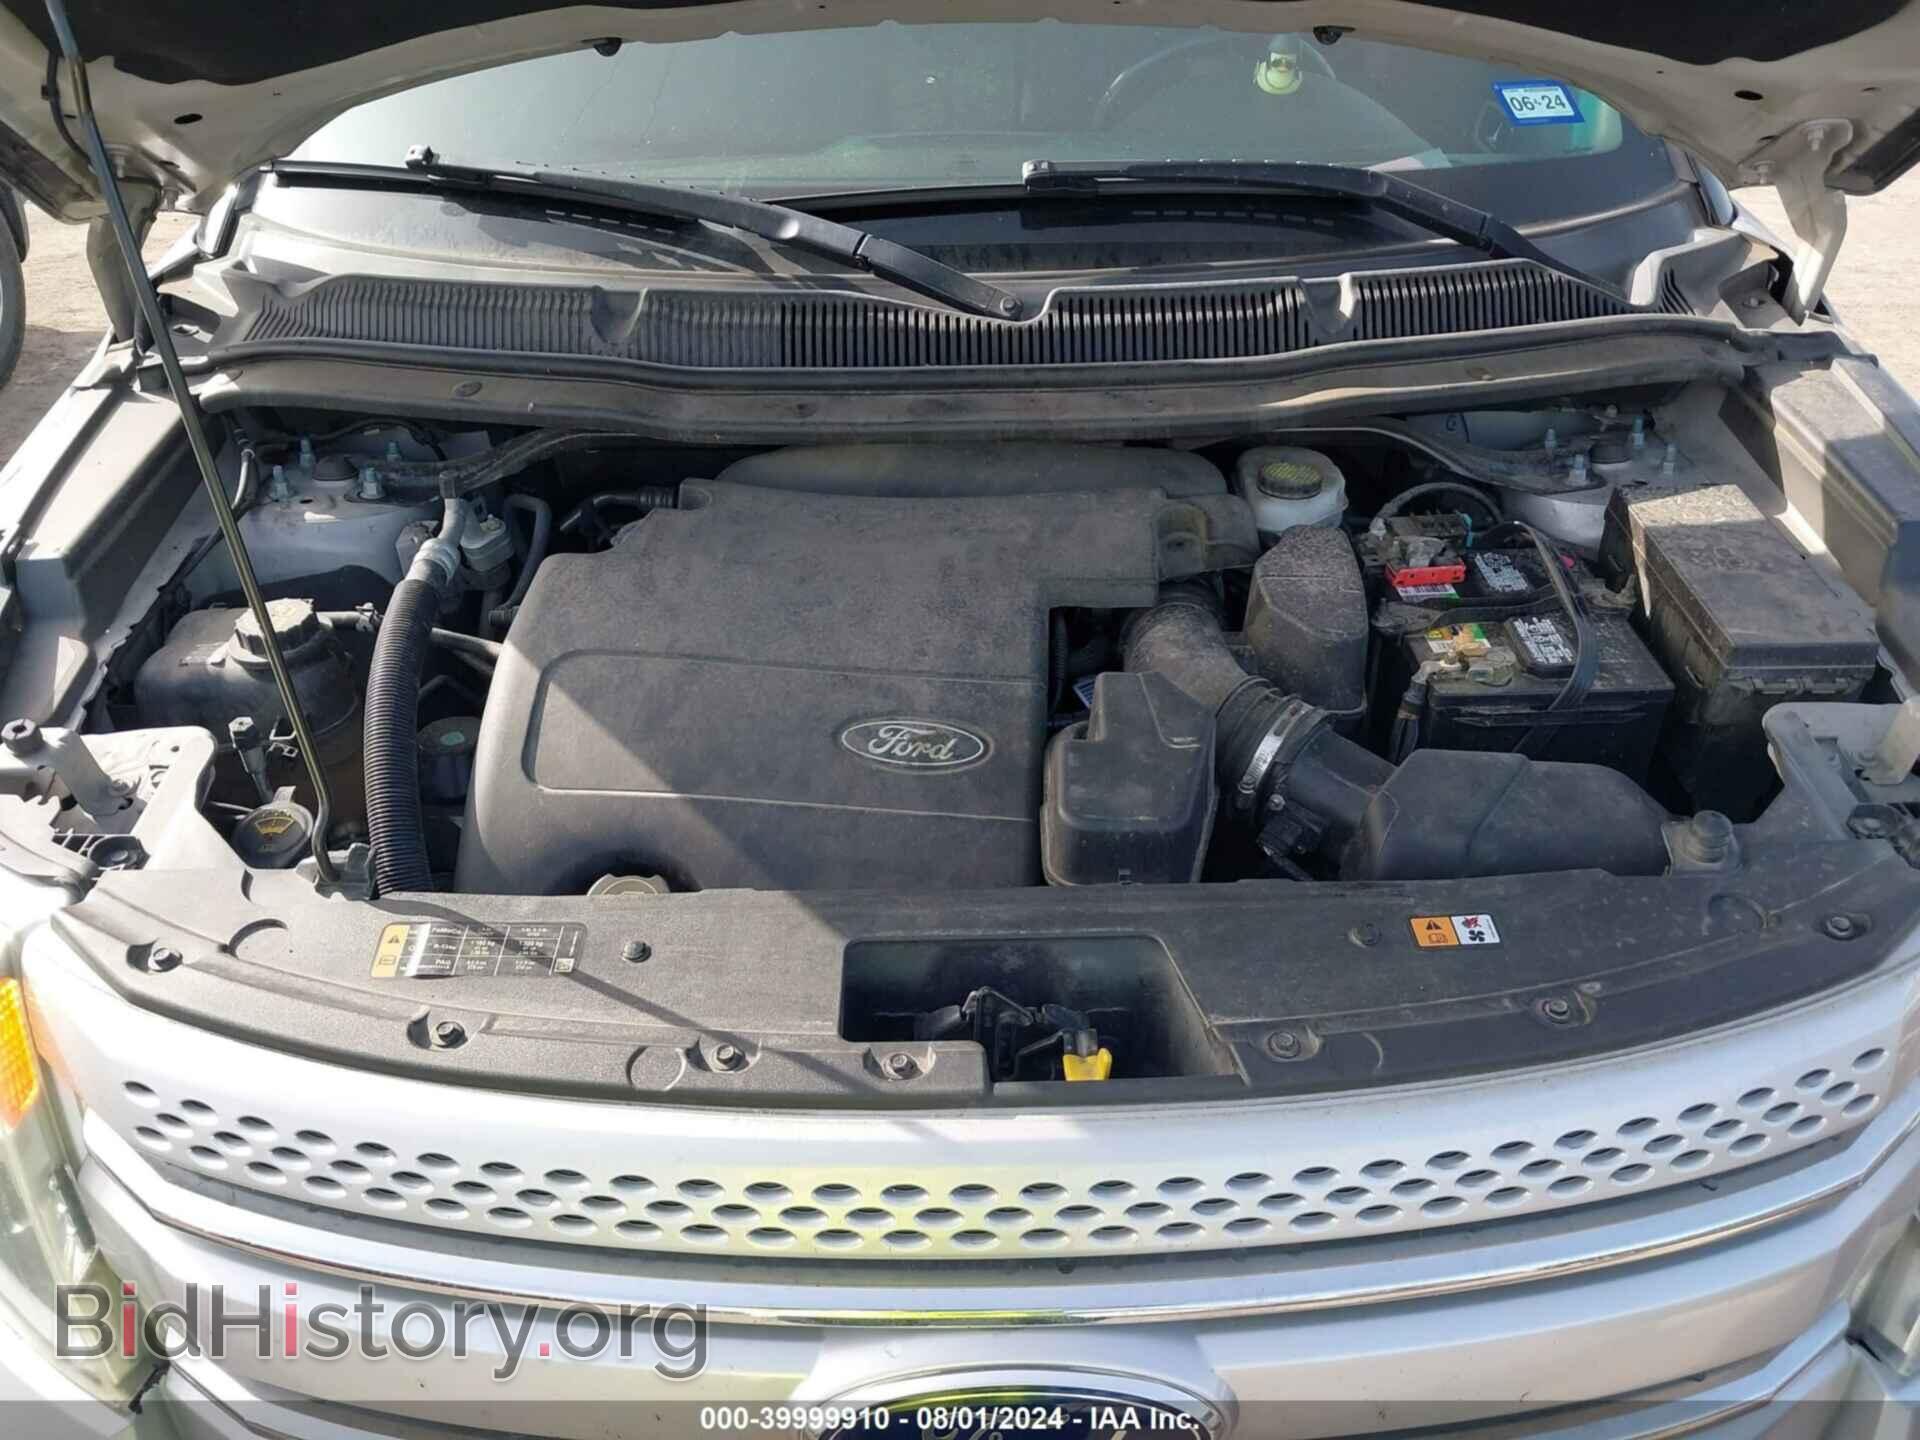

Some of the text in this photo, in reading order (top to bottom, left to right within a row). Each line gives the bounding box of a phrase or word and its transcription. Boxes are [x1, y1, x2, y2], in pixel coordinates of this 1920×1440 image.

[1510, 95, 1567, 111] 06 24
[868, 725, 958, 759] Ford
